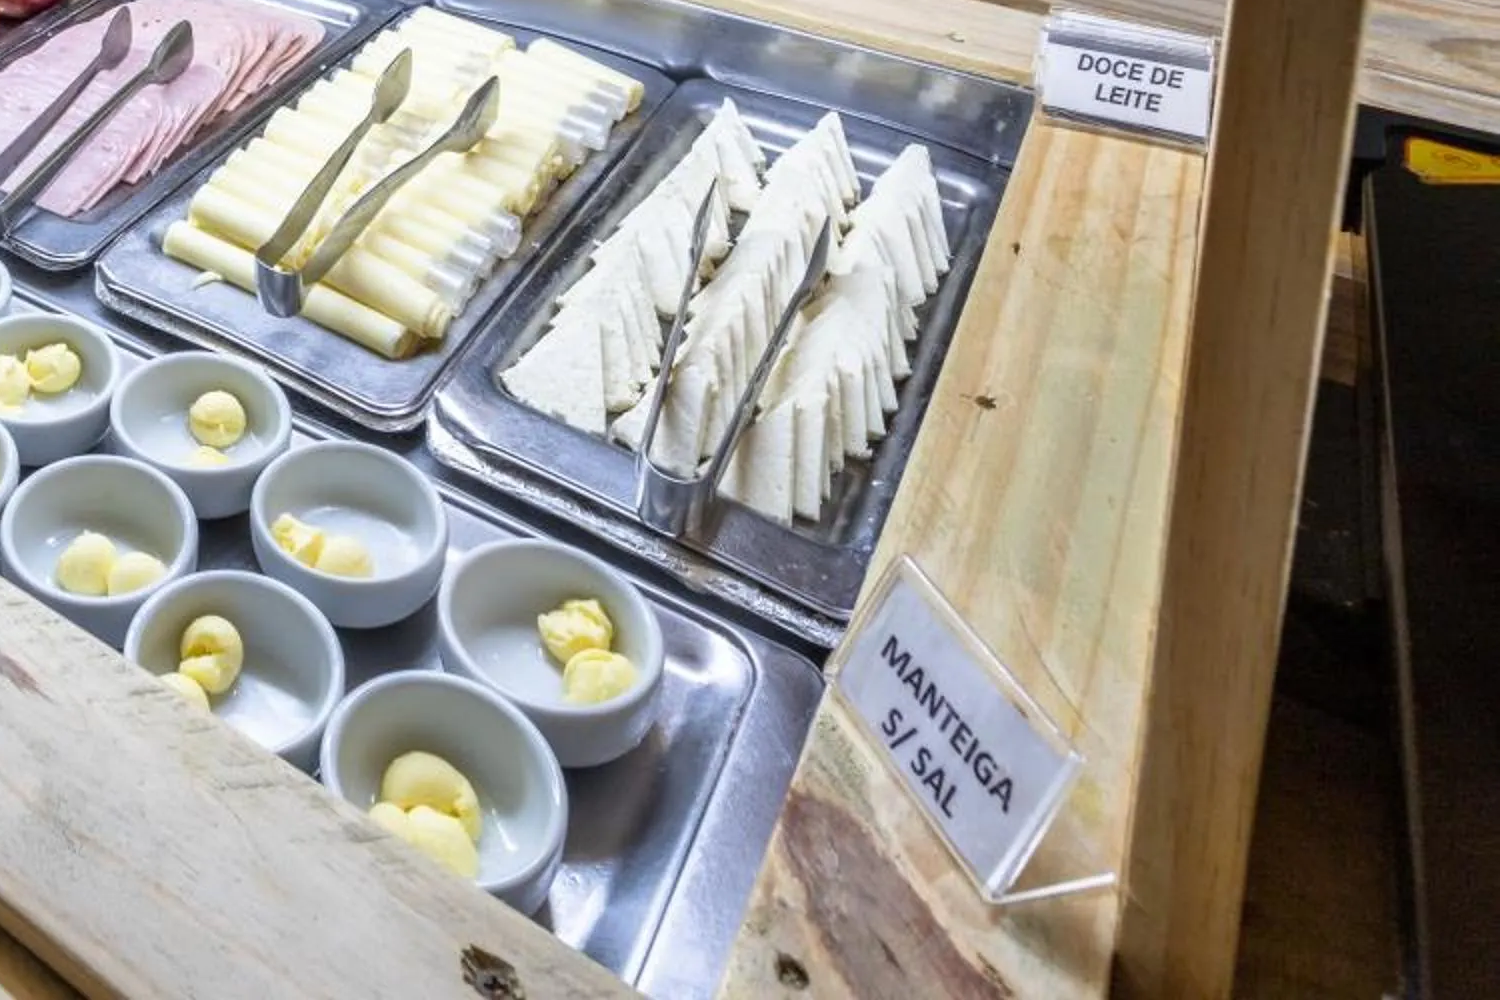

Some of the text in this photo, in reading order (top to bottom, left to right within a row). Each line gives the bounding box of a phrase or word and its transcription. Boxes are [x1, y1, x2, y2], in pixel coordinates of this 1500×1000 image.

[1077, 53, 1185, 89] DOCE DE
[1094, 83, 1164, 112] LEITE
[880, 635, 1015, 814] MANTEIGA
[881, 707, 961, 819] S/ SAL
